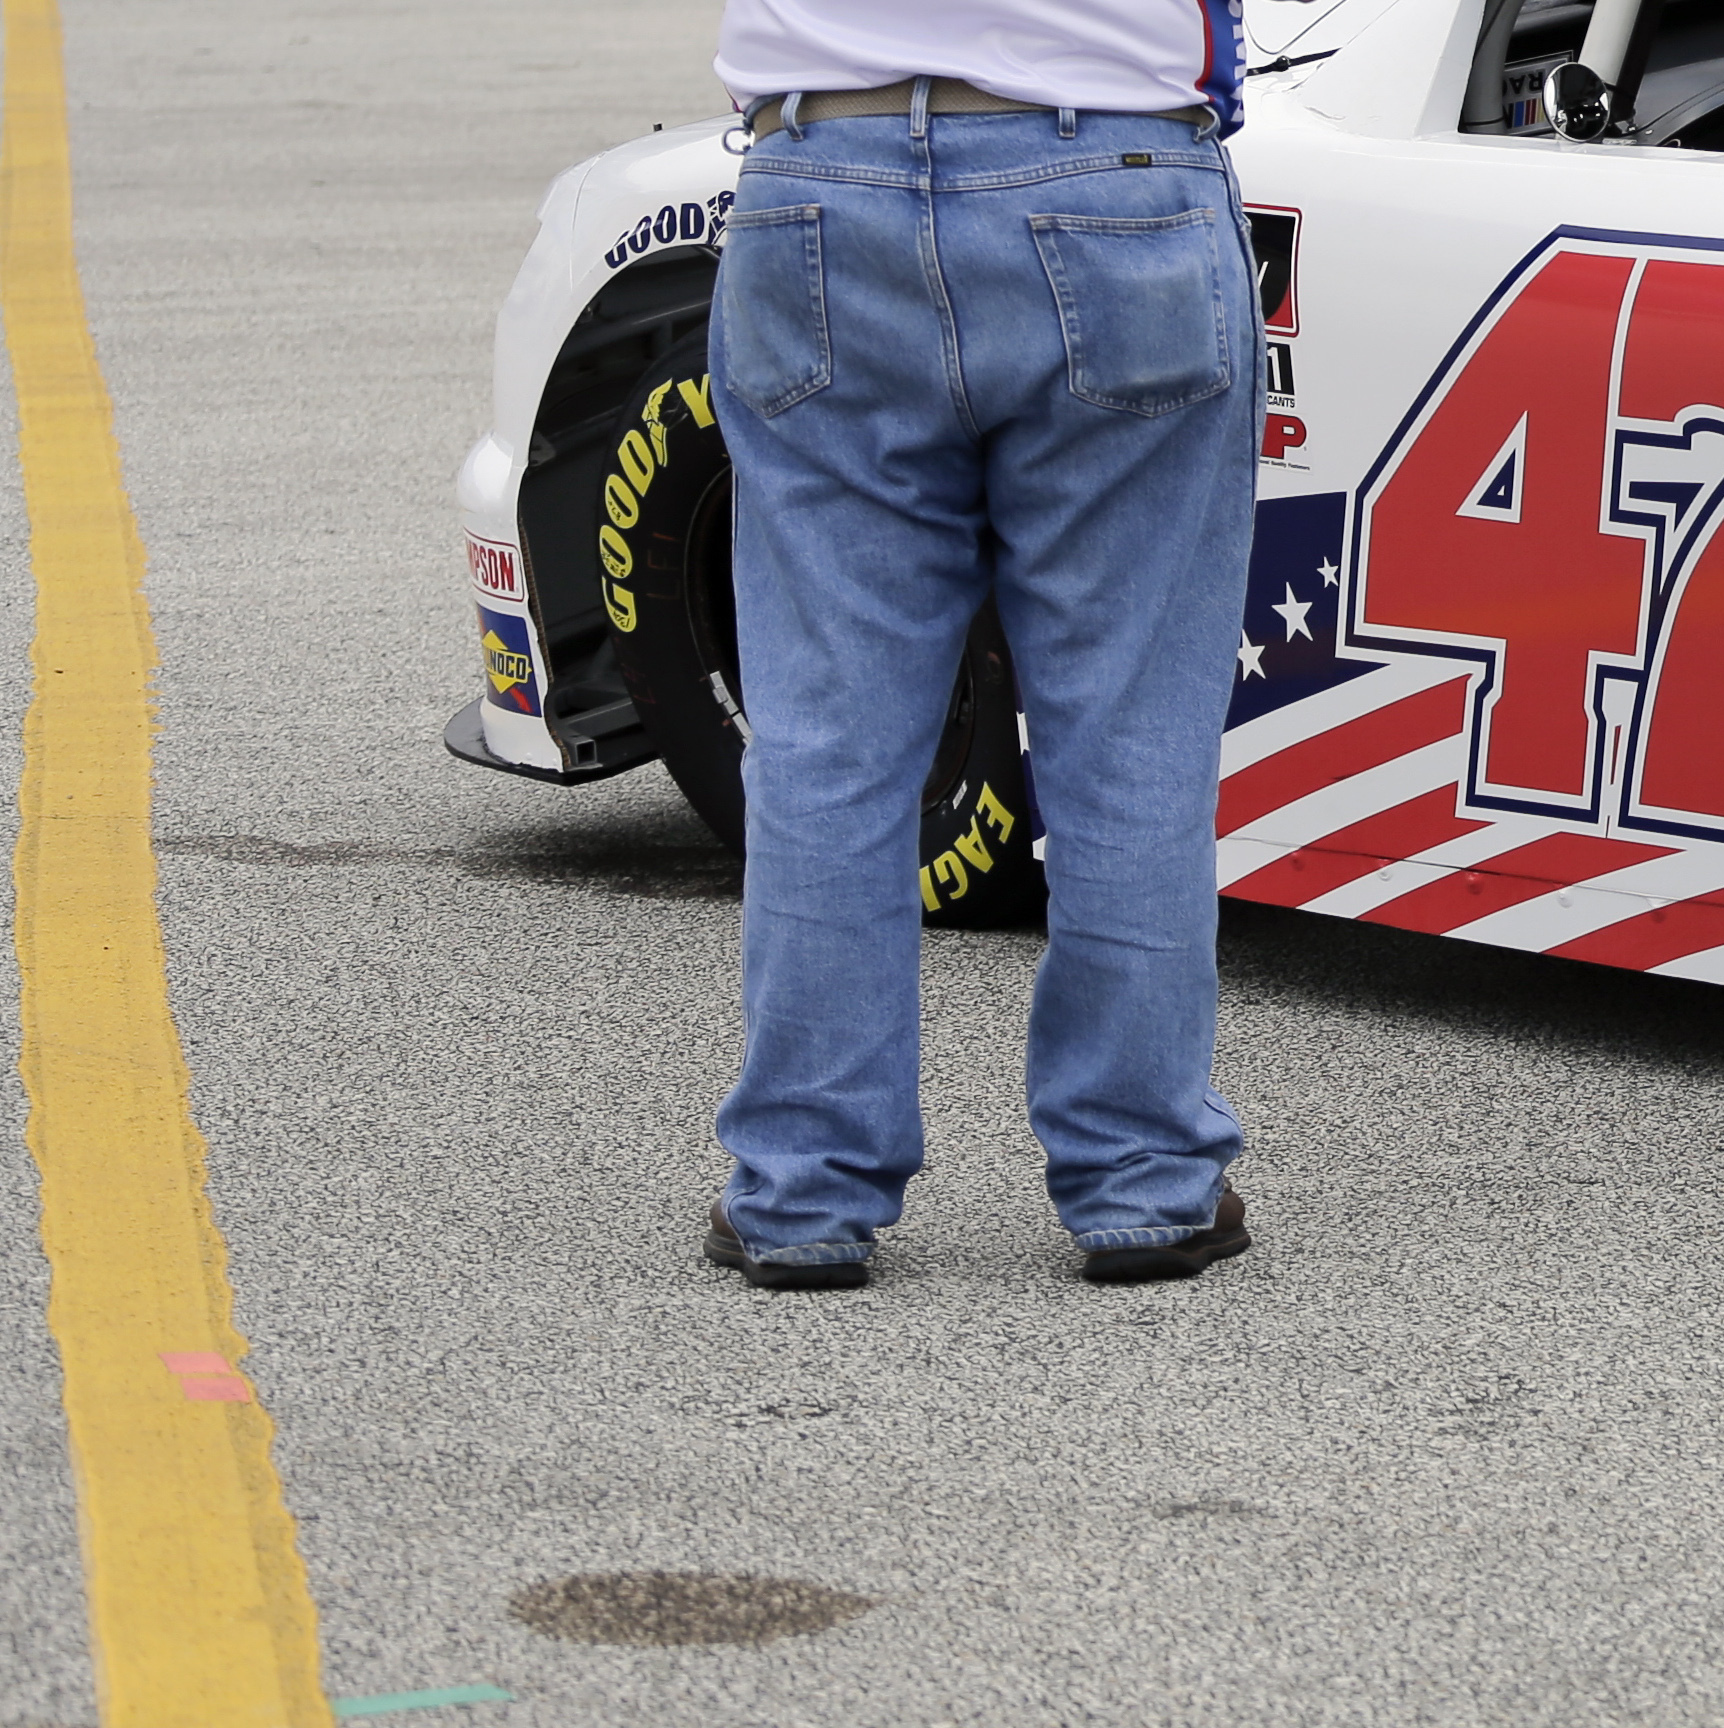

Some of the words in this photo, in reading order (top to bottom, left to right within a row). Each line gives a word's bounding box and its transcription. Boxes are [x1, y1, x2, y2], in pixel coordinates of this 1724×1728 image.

[604, 202, 705, 269] GOOD
[1266, 395, 1296, 409] CANTS
[600, 373, 716, 633] GOODY
